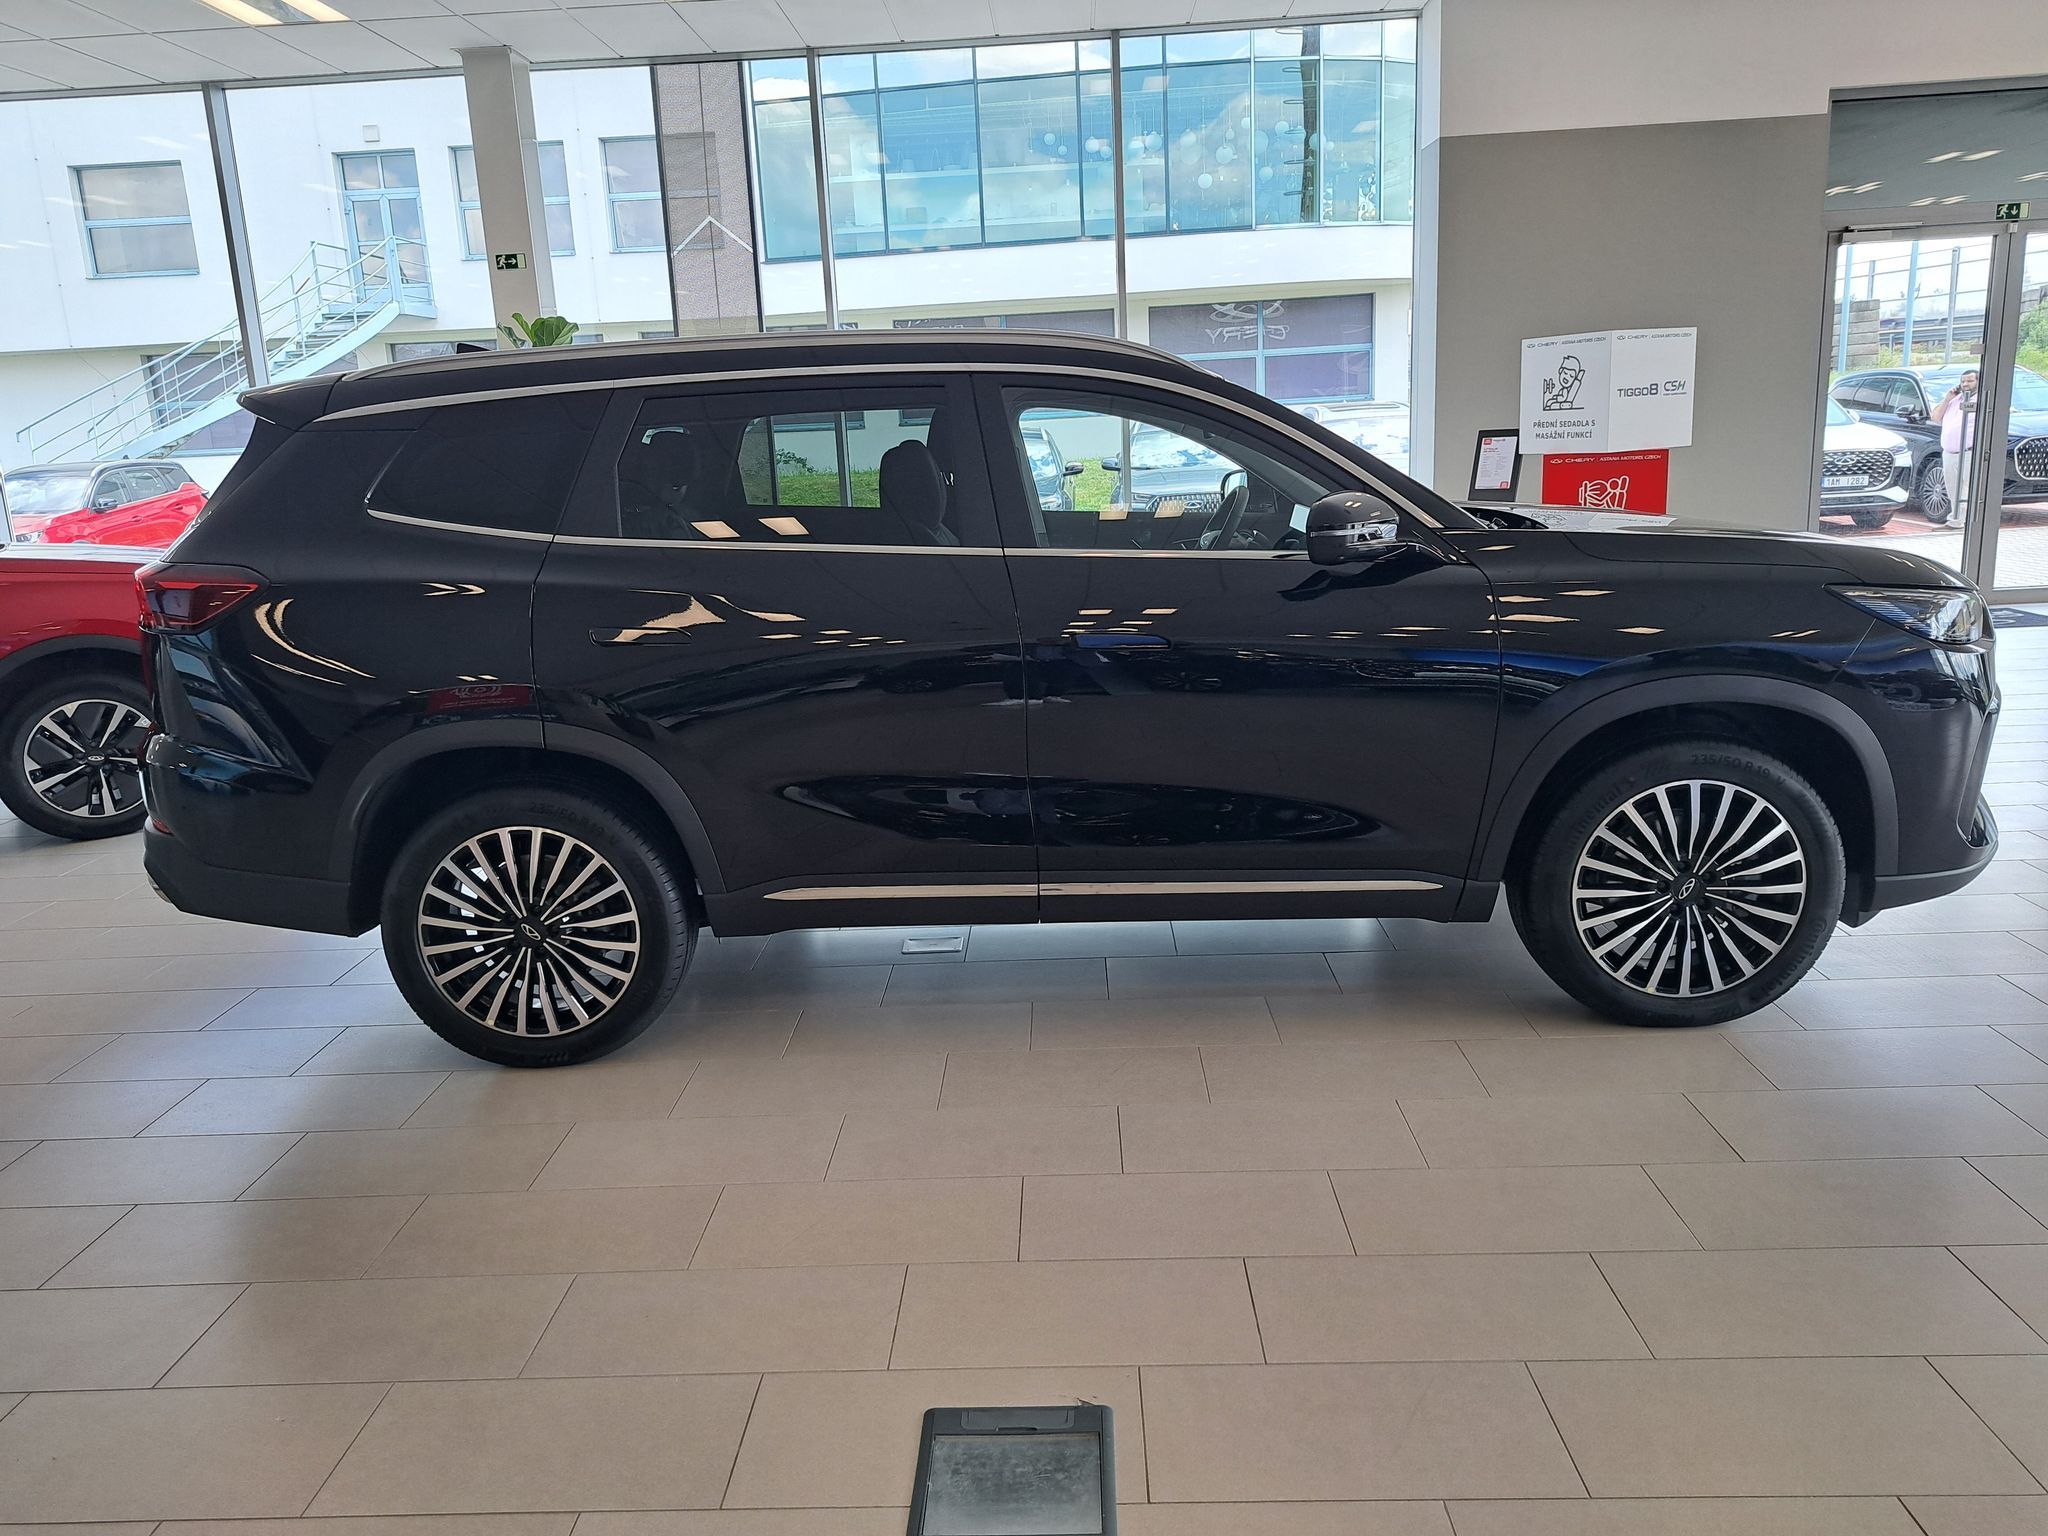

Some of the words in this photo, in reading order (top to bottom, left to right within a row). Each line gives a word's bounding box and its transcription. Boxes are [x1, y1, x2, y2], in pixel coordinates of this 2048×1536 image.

[1532, 418, 1558, 429] PŘEDNÍ
[1559, 419, 1590, 428] SEDADLA
[1590, 418, 1597, 427] S
[1535, 430, 1565, 440] MASÁŽNÍ
[1566, 428, 1593, 439] FUNKCÍ
